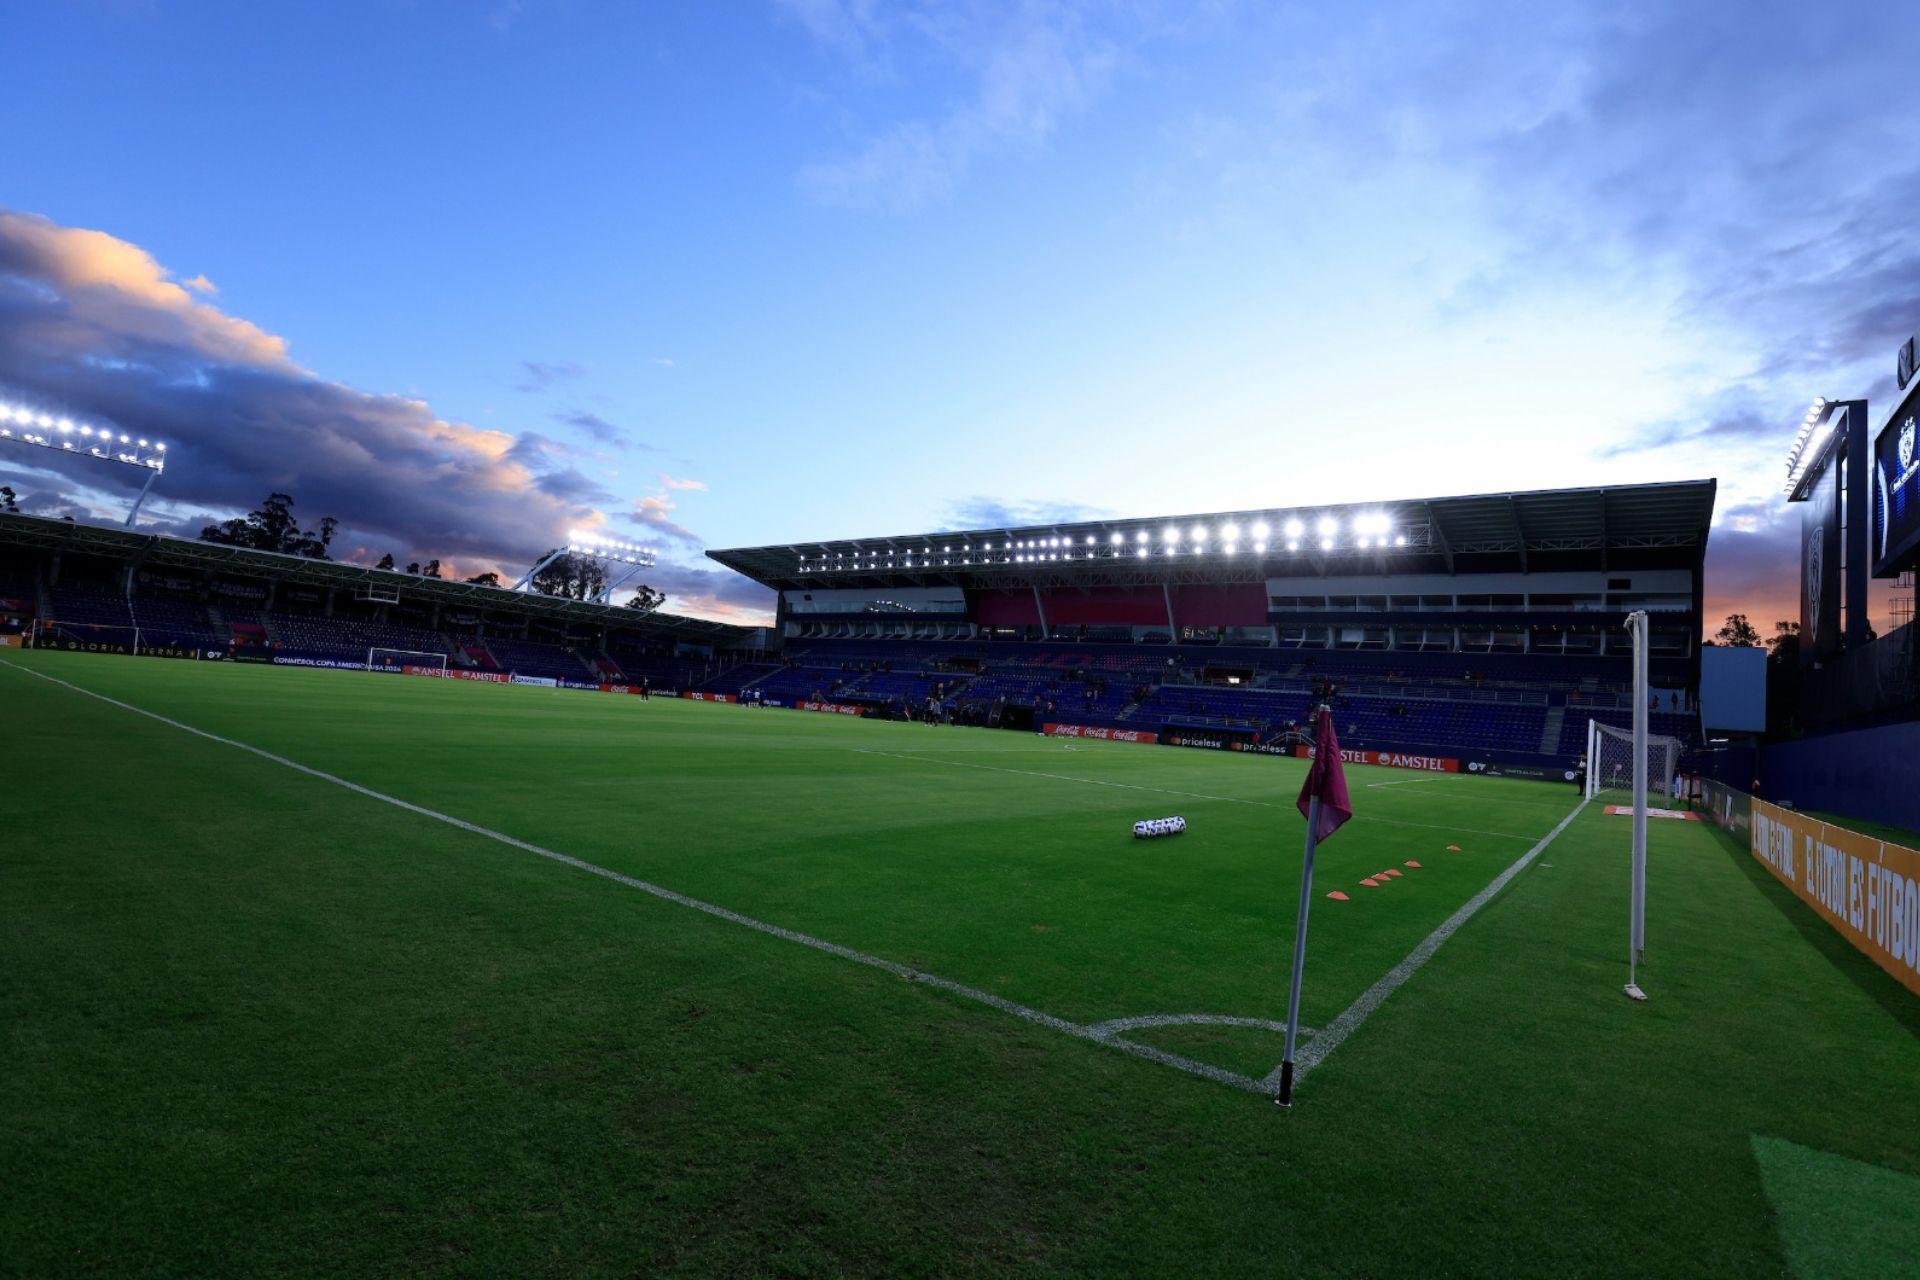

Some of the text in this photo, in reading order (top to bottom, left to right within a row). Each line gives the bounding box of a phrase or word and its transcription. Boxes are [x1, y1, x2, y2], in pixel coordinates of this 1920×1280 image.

[68, 641, 125, 653] GLORIA
[316, 659, 336, 668] COPA
[471, 672, 501, 682] AMSTEL
[692, 692, 704, 700] TCL
[1182, 736, 1221, 749] priceless
[1340, 750, 1369, 763] STEL
[1391, 753, 1444, 771] AMSTEL
[1816, 841, 1848, 922] FUTBOL
[1850, 855, 1864, 933] ES
